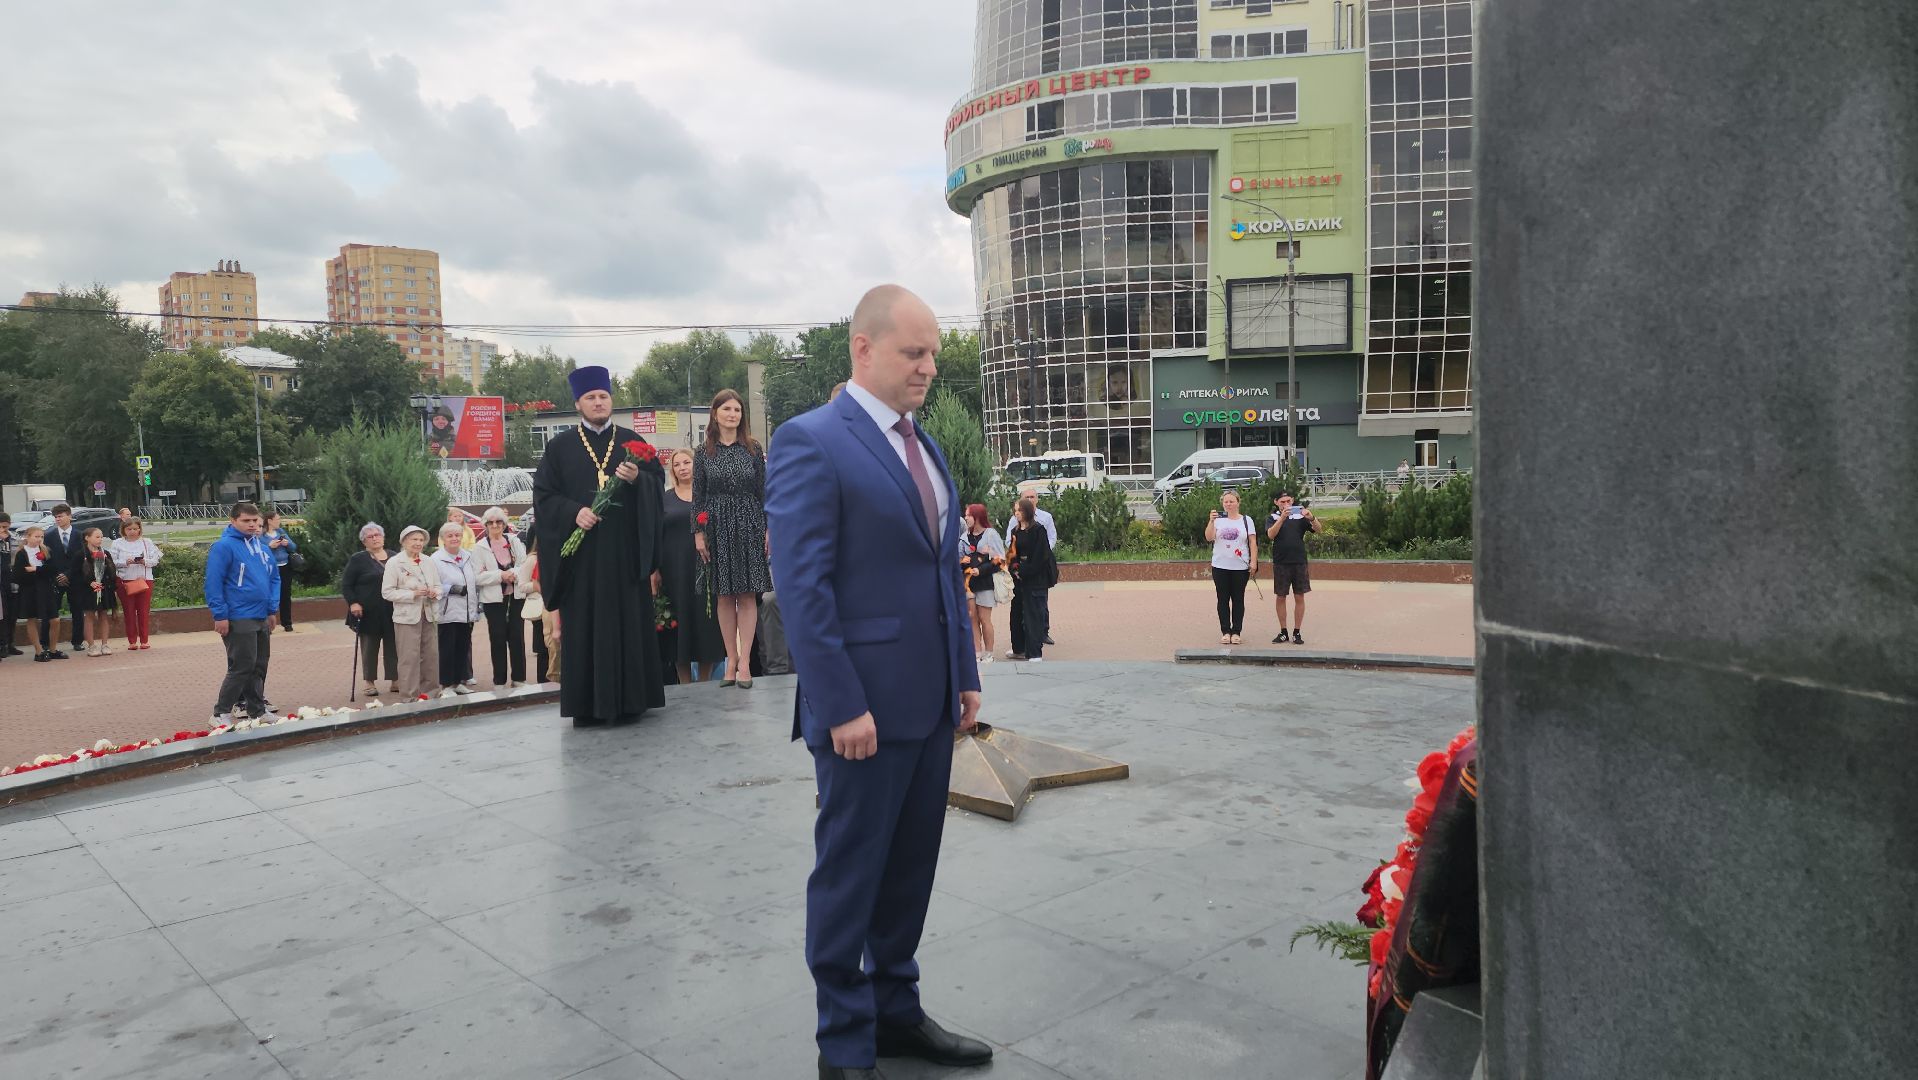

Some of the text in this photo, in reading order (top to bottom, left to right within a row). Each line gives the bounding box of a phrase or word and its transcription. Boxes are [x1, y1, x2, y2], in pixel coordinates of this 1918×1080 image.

[947, 67, 1151, 133] ОФИСНЫЙ ЦЕНТР
[992, 146, 1047, 168] ПИЦЦЕРИЯ
[1250, 174, 1343, 189] SUNLIGHT
[1248, 217, 1343, 234] КОРАБЛИК
[1179, 387, 1269, 399] АПТЕКА РИГЛА
[1182, 409, 1241, 426] супер
